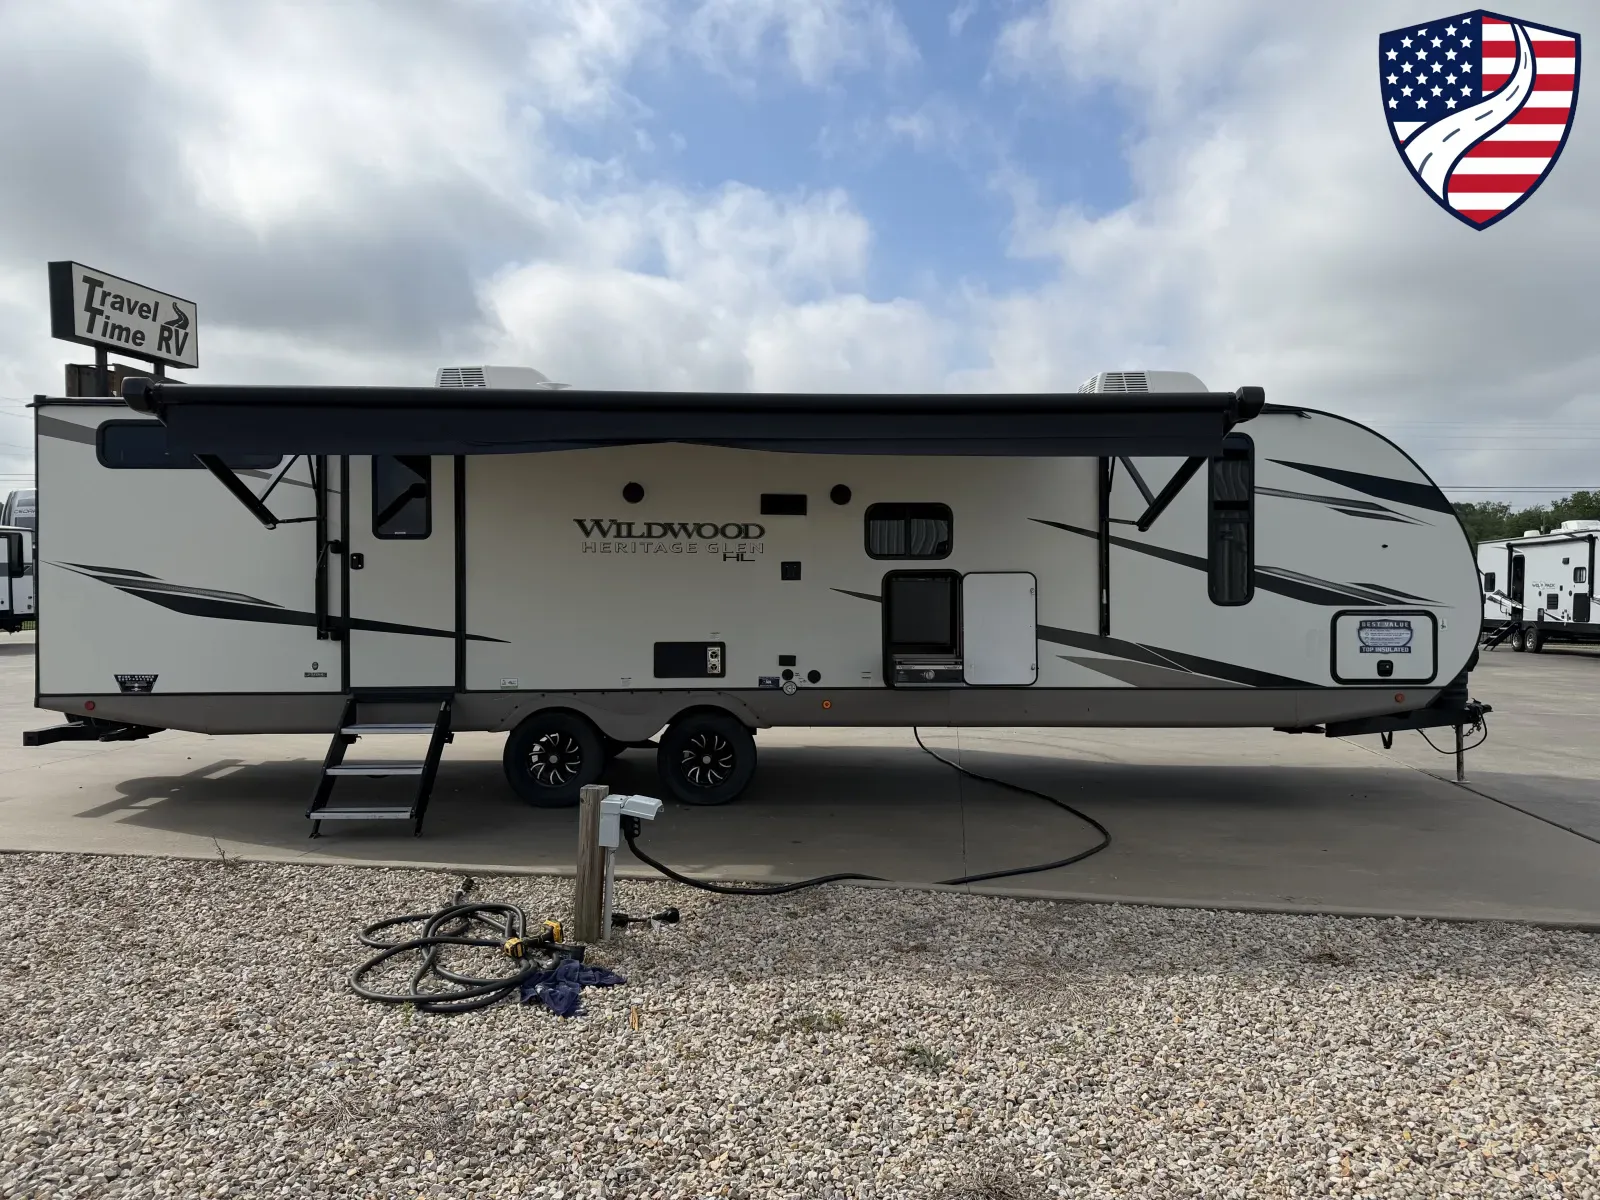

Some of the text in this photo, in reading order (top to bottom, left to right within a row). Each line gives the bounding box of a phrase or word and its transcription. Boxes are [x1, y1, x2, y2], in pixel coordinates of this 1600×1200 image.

[82, 275, 160, 322] Travel
[84, 307, 189, 356] Time RV
[581, 541, 764, 554] HERITAGE GLEN
[722, 553, 756, 562] HL
